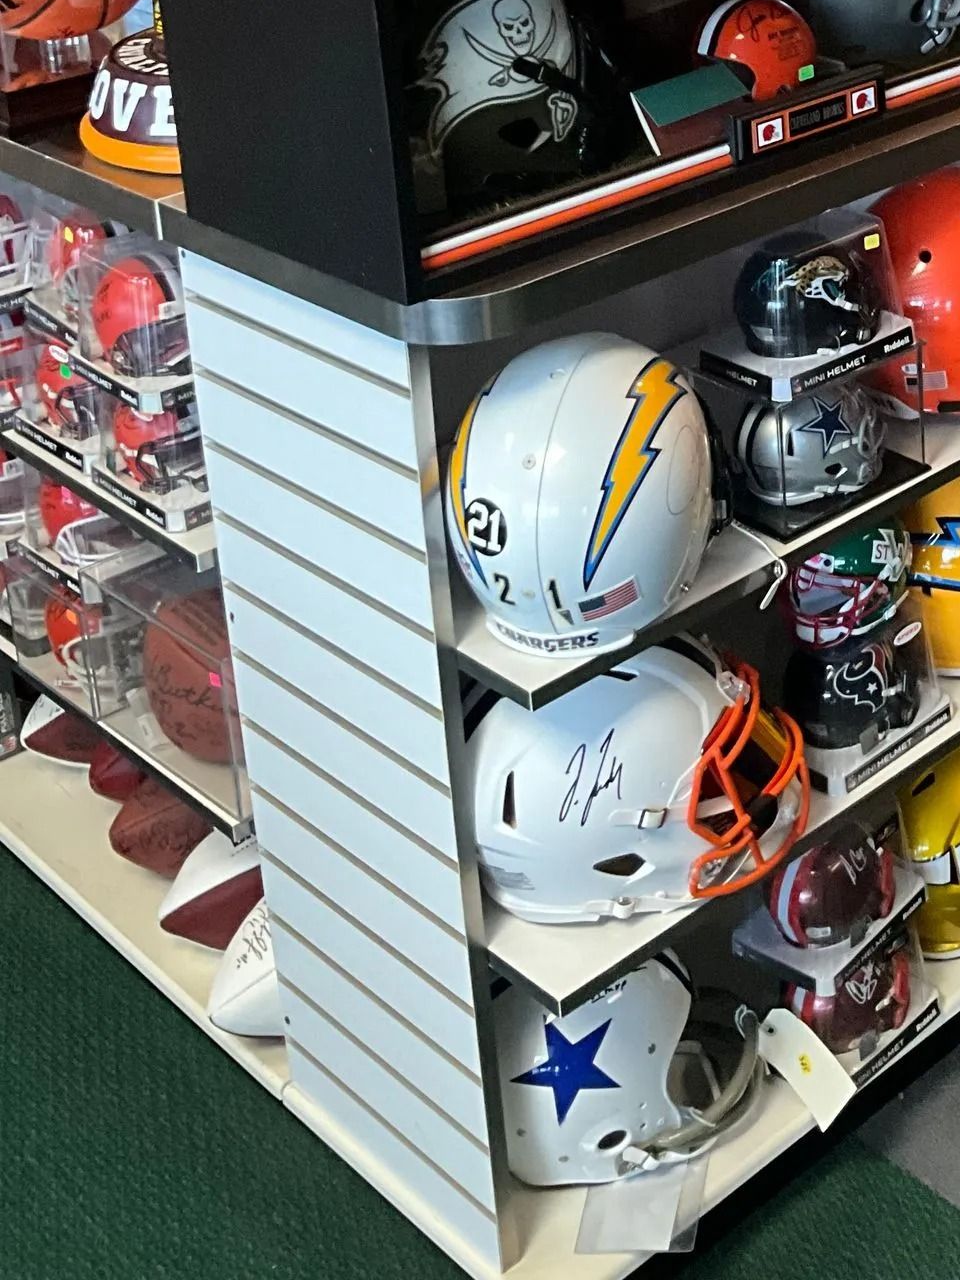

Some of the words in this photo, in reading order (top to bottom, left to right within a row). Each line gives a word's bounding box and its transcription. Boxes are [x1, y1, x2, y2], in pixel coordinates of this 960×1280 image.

[89, 55, 178, 137] OVE
[725, 369, 758, 388] HELMET
[803, 372, 825, 388] MINI
[826, 354, 867, 379] HELMET
[883, 335, 910, 354] Riddell
[467, 501, 502, 552] 21
[495, 621, 600, 653] CHARGERS
[857, 763, 876, 781] MINI
[877, 737, 913, 768] HELMET
[861, 926, 892, 960] HELMET
[871, 1037, 905, 1073] HELMET
